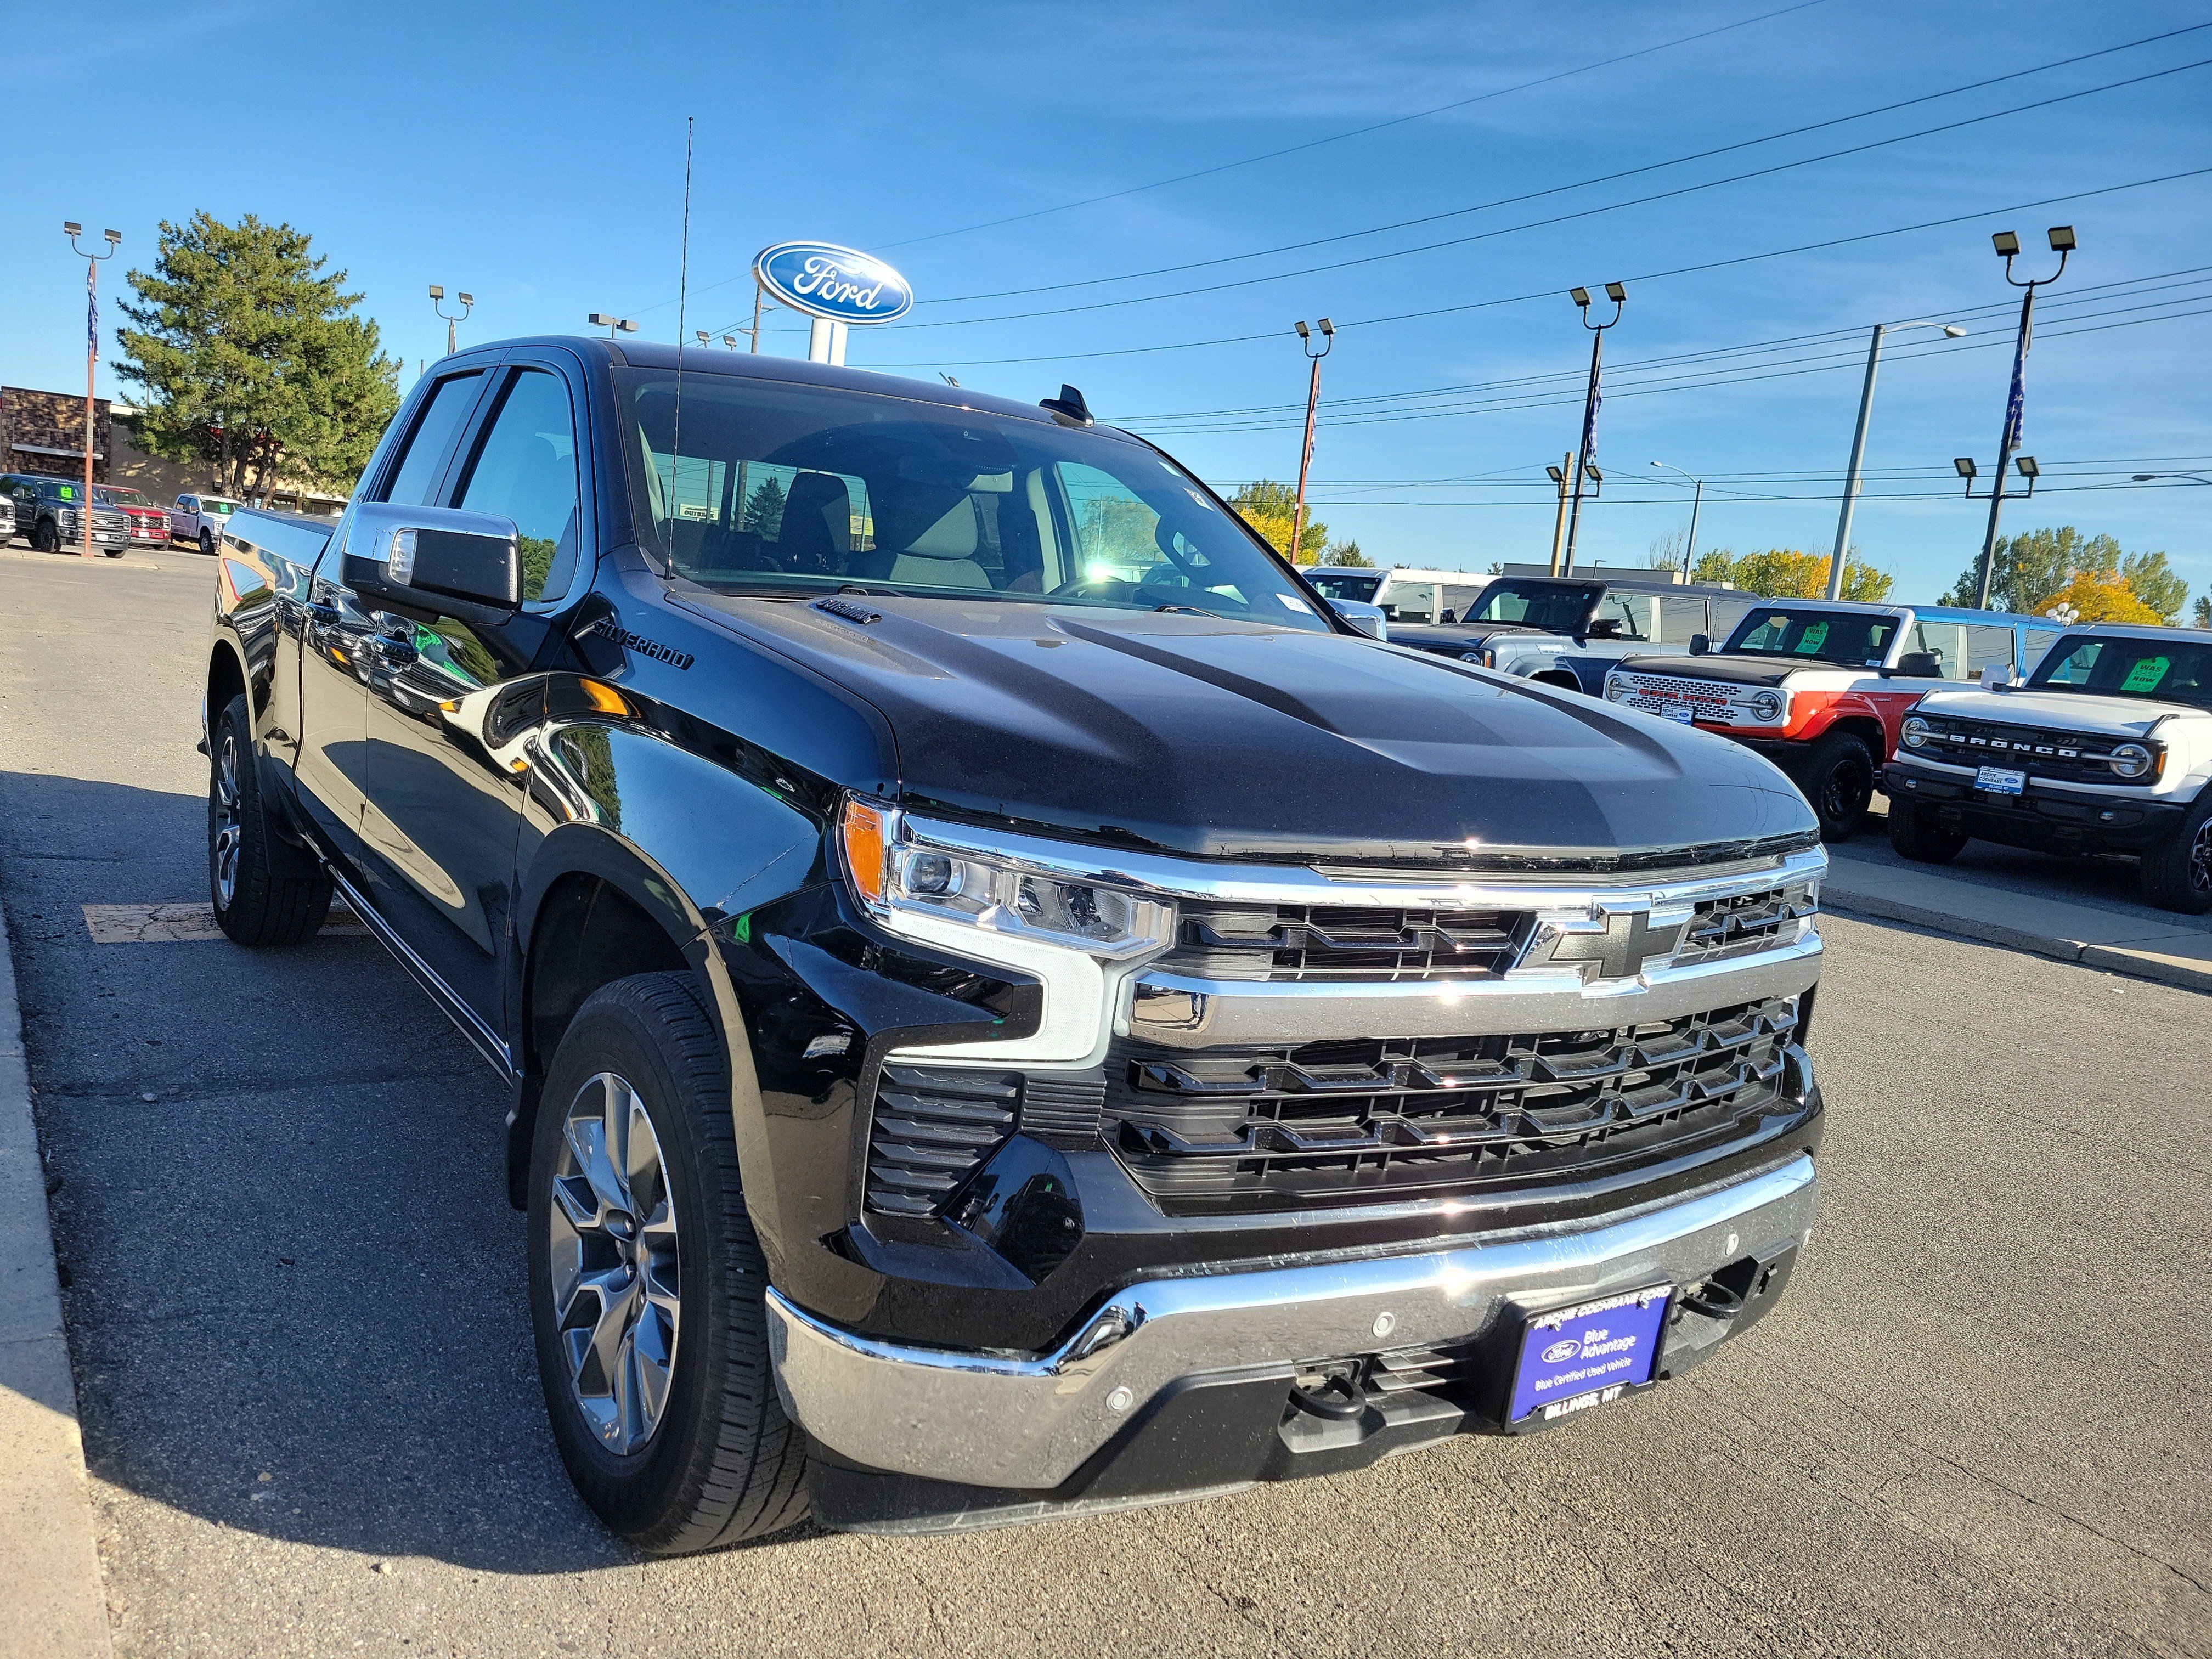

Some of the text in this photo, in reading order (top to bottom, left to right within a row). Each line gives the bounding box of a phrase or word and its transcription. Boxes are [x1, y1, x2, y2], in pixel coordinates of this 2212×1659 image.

[794, 256, 885, 310] Ford
[684, 510, 714, 519] OUTBAK
[594, 620, 695, 671] SILVERADO
[1949, 735, 2077, 758] BRONCO
[1578, 1293, 1641, 1318] COCHRANE
[1639, 1286, 1671, 1302] FORD
[1580, 1335, 1636, 1360] Advantage
[1584, 1329, 1609, 1344] Blue
[1548, 1344, 1575, 1361] Ford
[1535, 1357, 1632, 1391] Blue Certified Used Vehicle
[1601, 1386, 1623, 1403] MT
